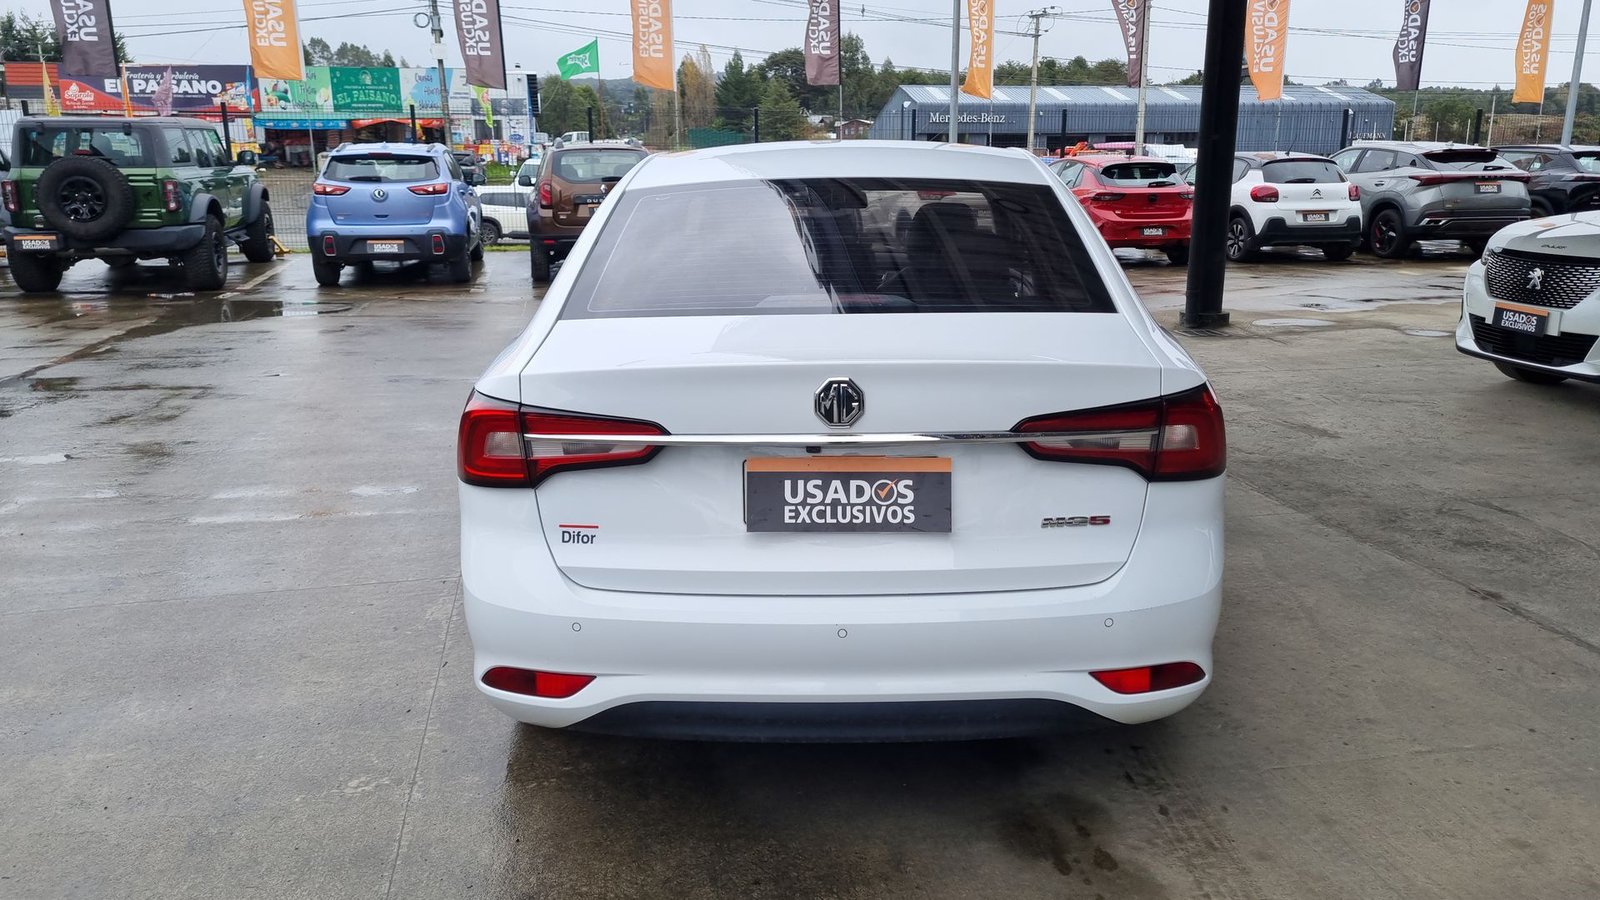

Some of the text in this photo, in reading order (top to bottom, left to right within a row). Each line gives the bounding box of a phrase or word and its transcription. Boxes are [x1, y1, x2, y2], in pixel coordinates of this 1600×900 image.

[133, 80, 222, 94] PASANO
[352, 90, 397, 105] PAISANO
[929, 112, 1006, 123] Meredes-Benz
[1502, 311, 1537, 325] USADOS
[1501, 320, 1536, 332] EXCLUSIVOS
[819, 383, 860, 424] MG
[784, 478, 915, 505] USADOS
[784, 505, 916, 524] EXCLUSIVOS
[1041, 515, 1111, 528] MG5
[561, 530, 596, 544] Difor
